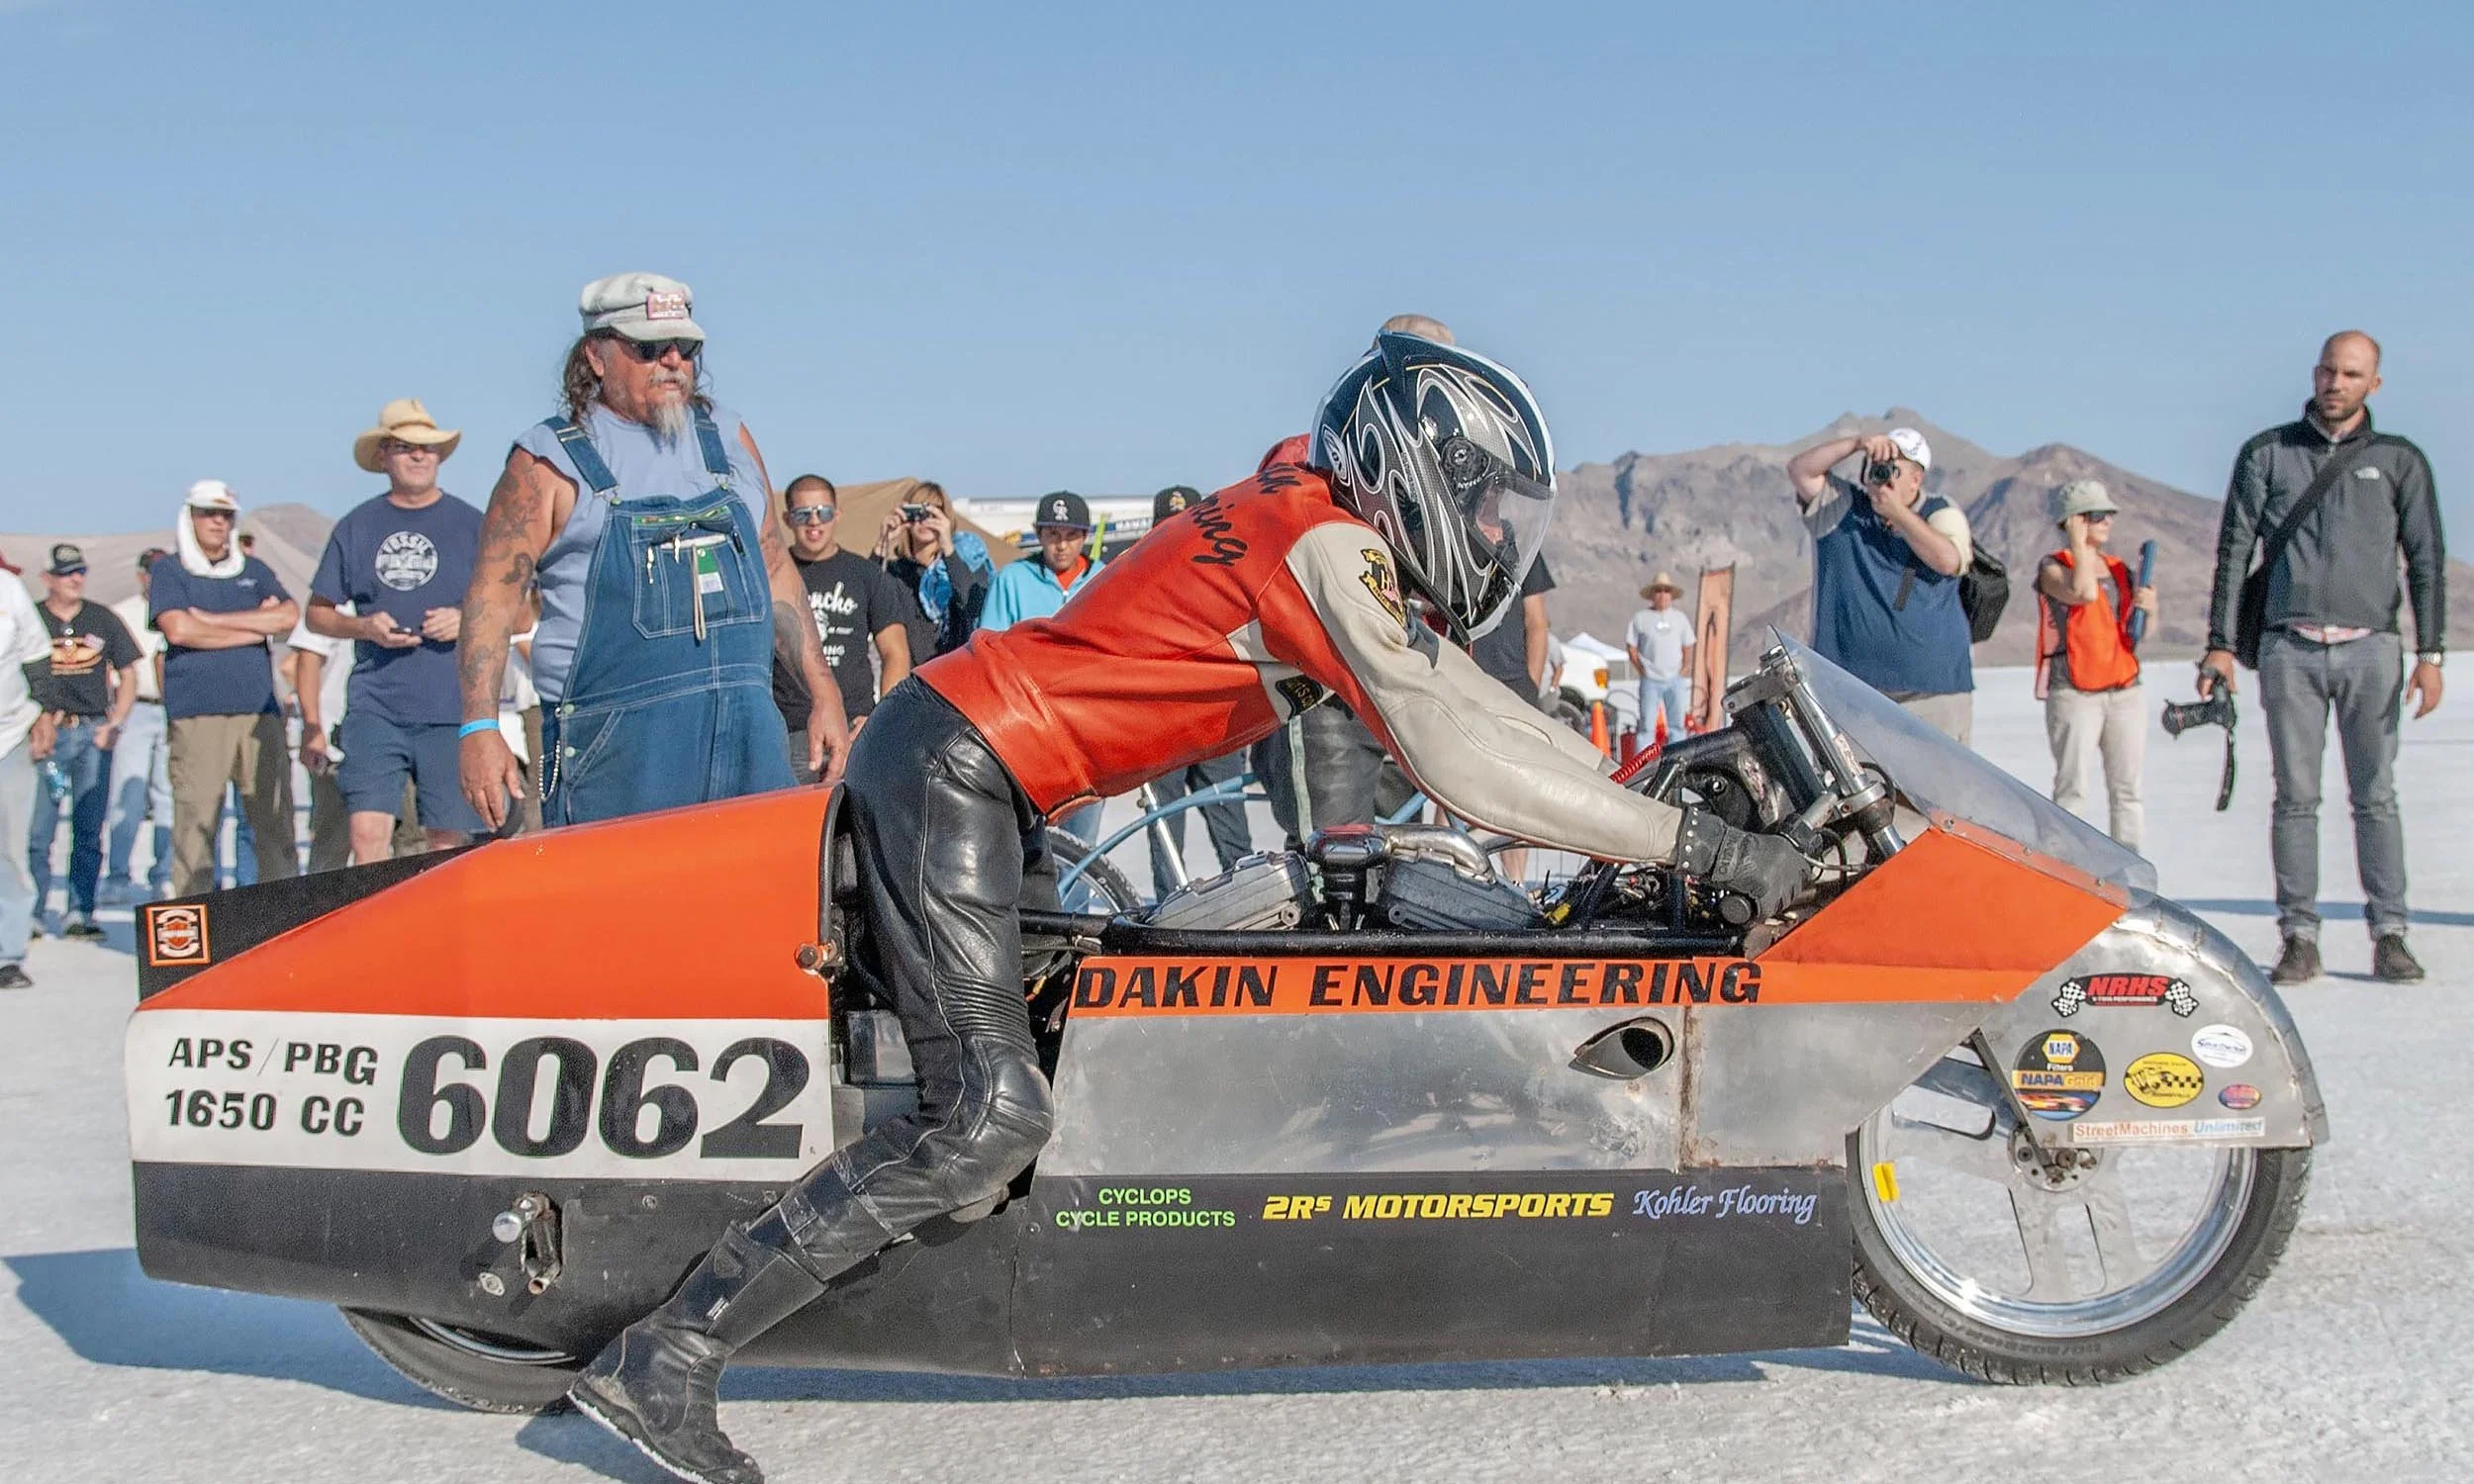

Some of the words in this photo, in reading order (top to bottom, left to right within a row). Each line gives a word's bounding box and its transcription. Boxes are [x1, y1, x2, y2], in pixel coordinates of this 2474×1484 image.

[807, 581, 858, 615] ncho
[1074, 965, 1278, 1009] DAKIN
[1309, 962, 1762, 1007] ENGINEERING
[2086, 975, 2169, 997] NRHS
[2047, 1041, 2073, 1056] NAPA
[2021, 1072, 2064, 1086] NAPA
[398, 1035, 810, 1159] 6062
[166, 1088, 277, 1131] 1650
[300, 1095, 365, 1138] CC
[1098, 1187, 1192, 1205] CYCLOPS
[1342, 1192, 1616, 1220] MOTORSPORTS
[1633, 1184, 1714, 1220] Kohler
[1715, 1183, 1818, 1226] Flooring
[1055, 1210, 1120, 1227] CYCLE
[1126, 1210, 1236, 1227] PRODUCTS
